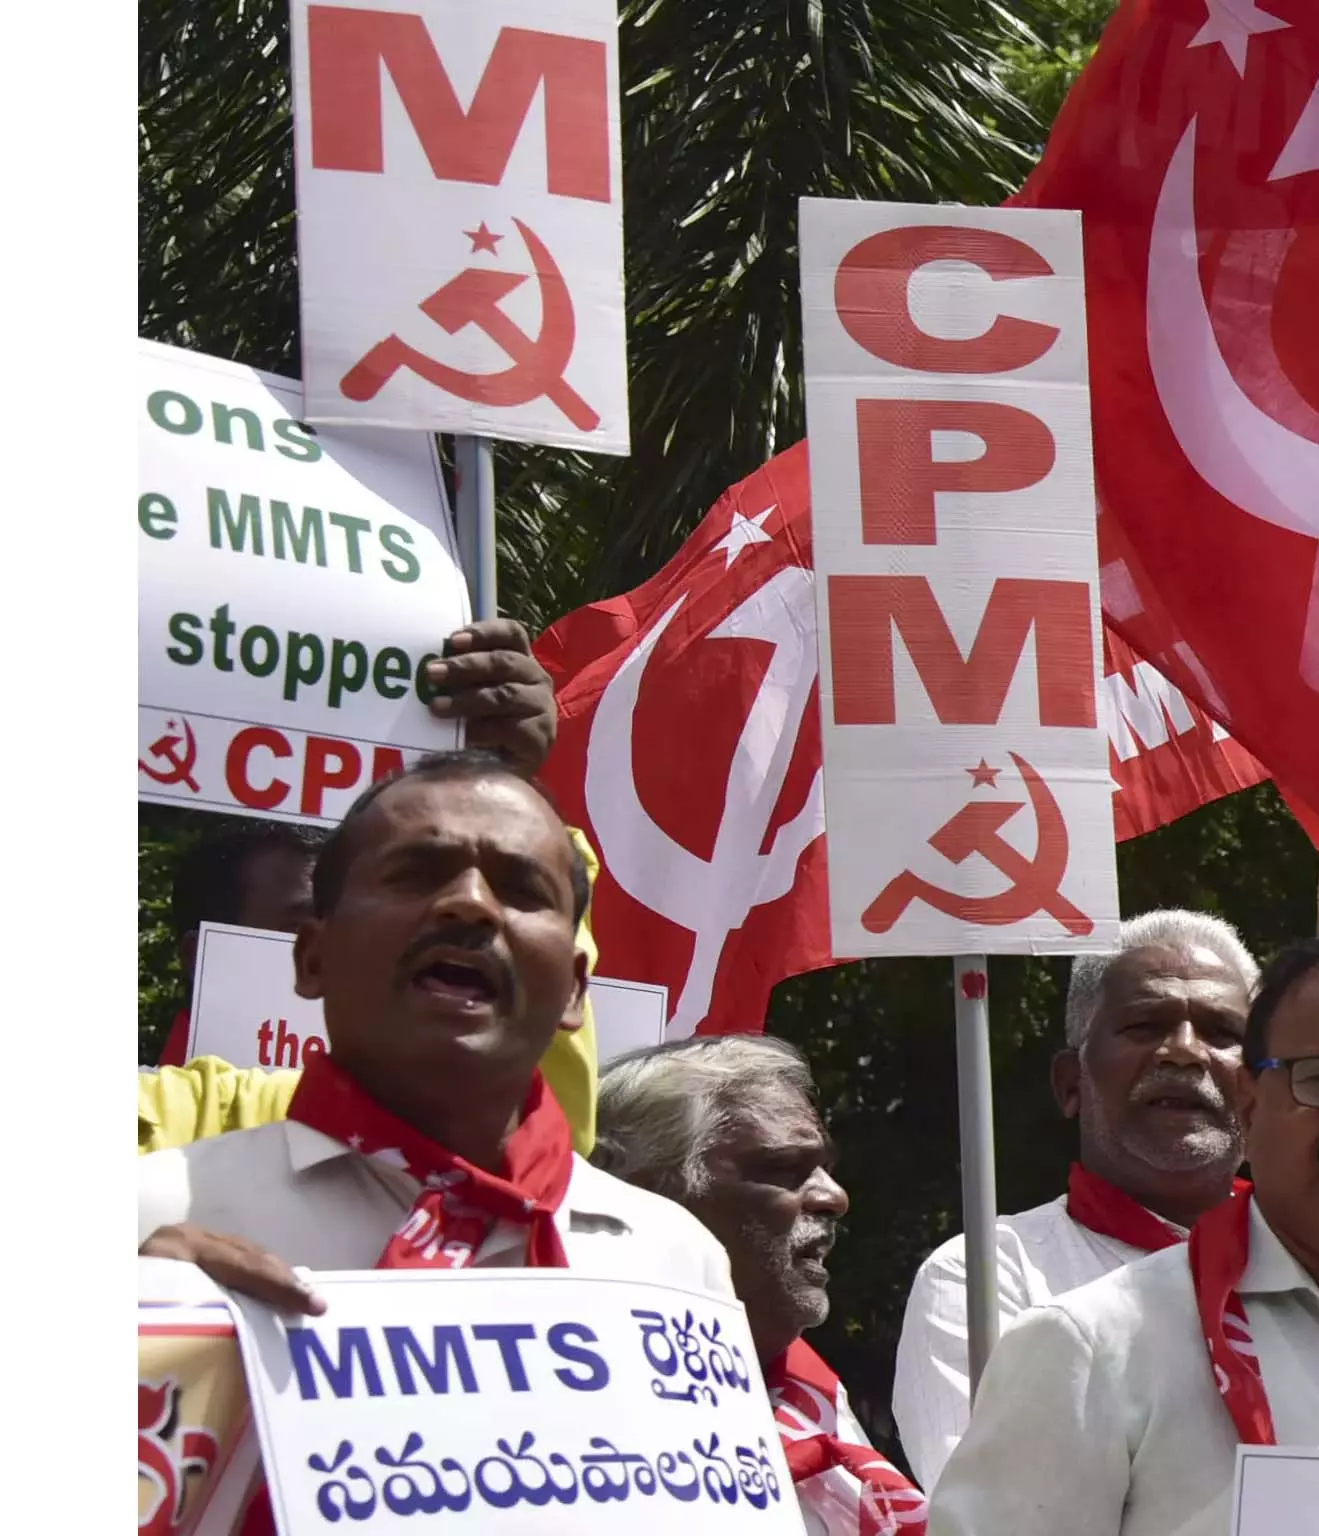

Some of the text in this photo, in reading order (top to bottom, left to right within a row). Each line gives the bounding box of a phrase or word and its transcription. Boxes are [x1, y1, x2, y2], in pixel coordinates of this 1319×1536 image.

[206, 487, 422, 584] MMTS
[225, 726, 404, 815] CP
[286, 1322, 610, 1401] MMTS
[307, 1431, 780, 1522] సమయపాలనతో
